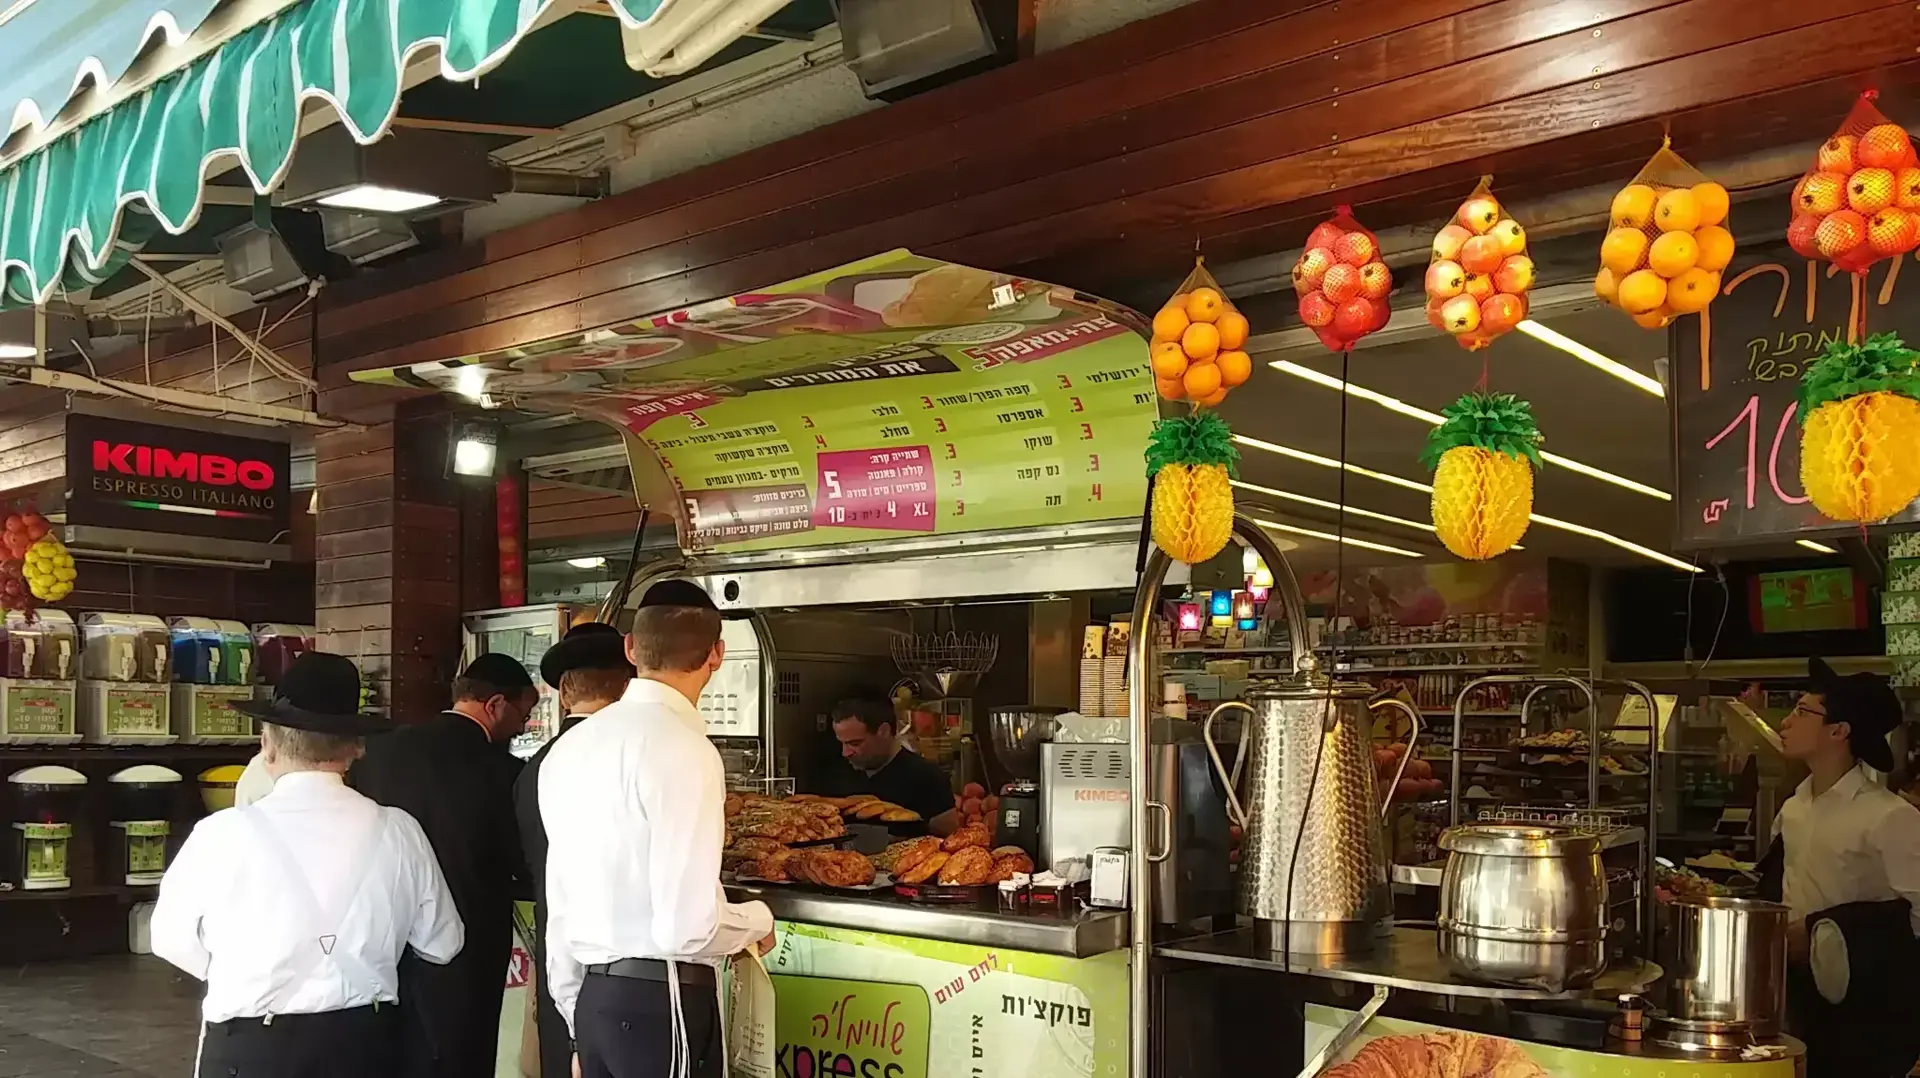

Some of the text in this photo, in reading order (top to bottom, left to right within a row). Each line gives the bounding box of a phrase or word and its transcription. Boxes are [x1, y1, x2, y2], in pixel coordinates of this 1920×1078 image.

[1746, 326, 1842, 371] מתוק
[764, 365, 879, 388] המחירים
[880, 361, 927, 376] את
[1086, 366, 1140, 384] ירושלמי
[1008, 384, 1031, 397] קפה
[871, 405, 899, 417] מלבי
[997, 408, 1044, 424] אספרסו
[1023, 435, 1053, 450] שוקו
[93, 440, 275, 491] KIMBO
[769, 466, 800, 479] מרקים
[902, 465, 924, 477] קולה
[1017, 466, 1042, 481] קפה
[93, 476, 275, 509] ESPRESSO ITALIANO
[823, 470, 842, 499] 5
[1045, 494, 1061, 507] תה
[828, 506, 845, 523] 10
[913, 502, 929, 517] XL
[933, 952, 999, 1005] לחם שום
[1001, 994, 1091, 1028] פוקצ'ות
